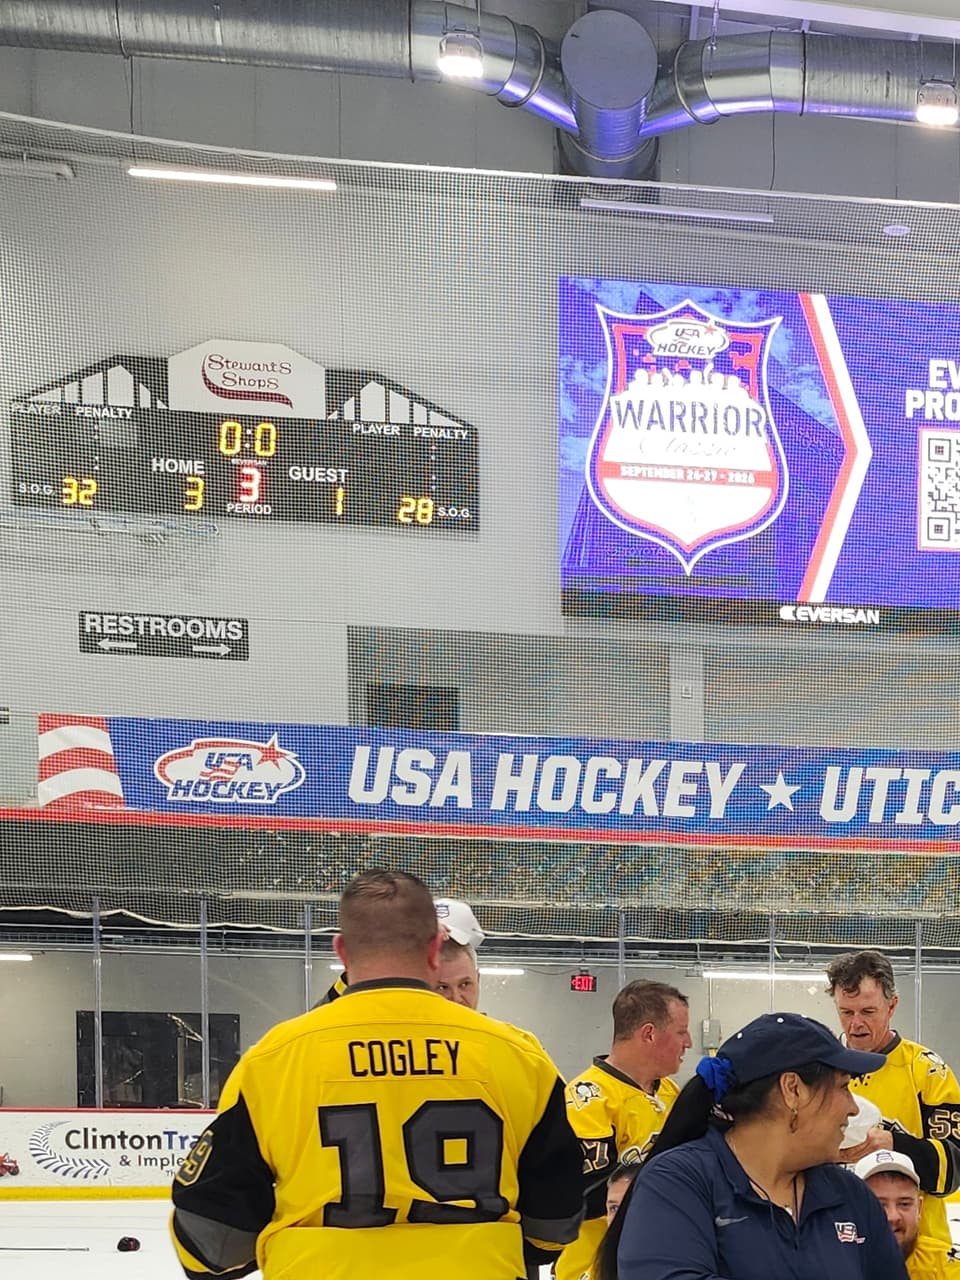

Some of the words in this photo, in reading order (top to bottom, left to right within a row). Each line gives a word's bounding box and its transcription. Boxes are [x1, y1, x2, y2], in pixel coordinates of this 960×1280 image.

[656, 343, 716, 356] HOCKEY
[75, 407, 133, 419] PENALTY
[614, 399, 763, 438] WARRIOR
[352, 423, 401, 436] PLAYER
[413, 427, 469, 440] PENALTY
[152, 458, 205, 475] HOME
[289, 466, 349, 484] GUEST
[620, 465, 685, 480] SEPTEMBER
[61, 476, 98, 506] 32
[184, 477, 205, 511] 3
[239, 467, 262, 502] 3
[226, 503, 272, 515] PERIOD
[334, 487, 345, 516] 1
[397, 496, 434, 524] 28
[796, 606, 880, 625] EVERSAN
[84, 613, 244, 641] RESTROOMS
[203, 752, 254, 775] USA
[171, 779, 285, 801] HOCKEY
[348, 745, 474, 809] USA
[497, 752, 746, 820] HOCKEY
[575, 975, 594, 991] EXIT
[347, 1038, 461, 1078] COGLEY
[65, 1127, 201, 1150] ClintonTra
[119, 1154, 131, 1167] &
[137, 1153, 187, 1171] Imple
[317, 1097, 510, 1229] 19
